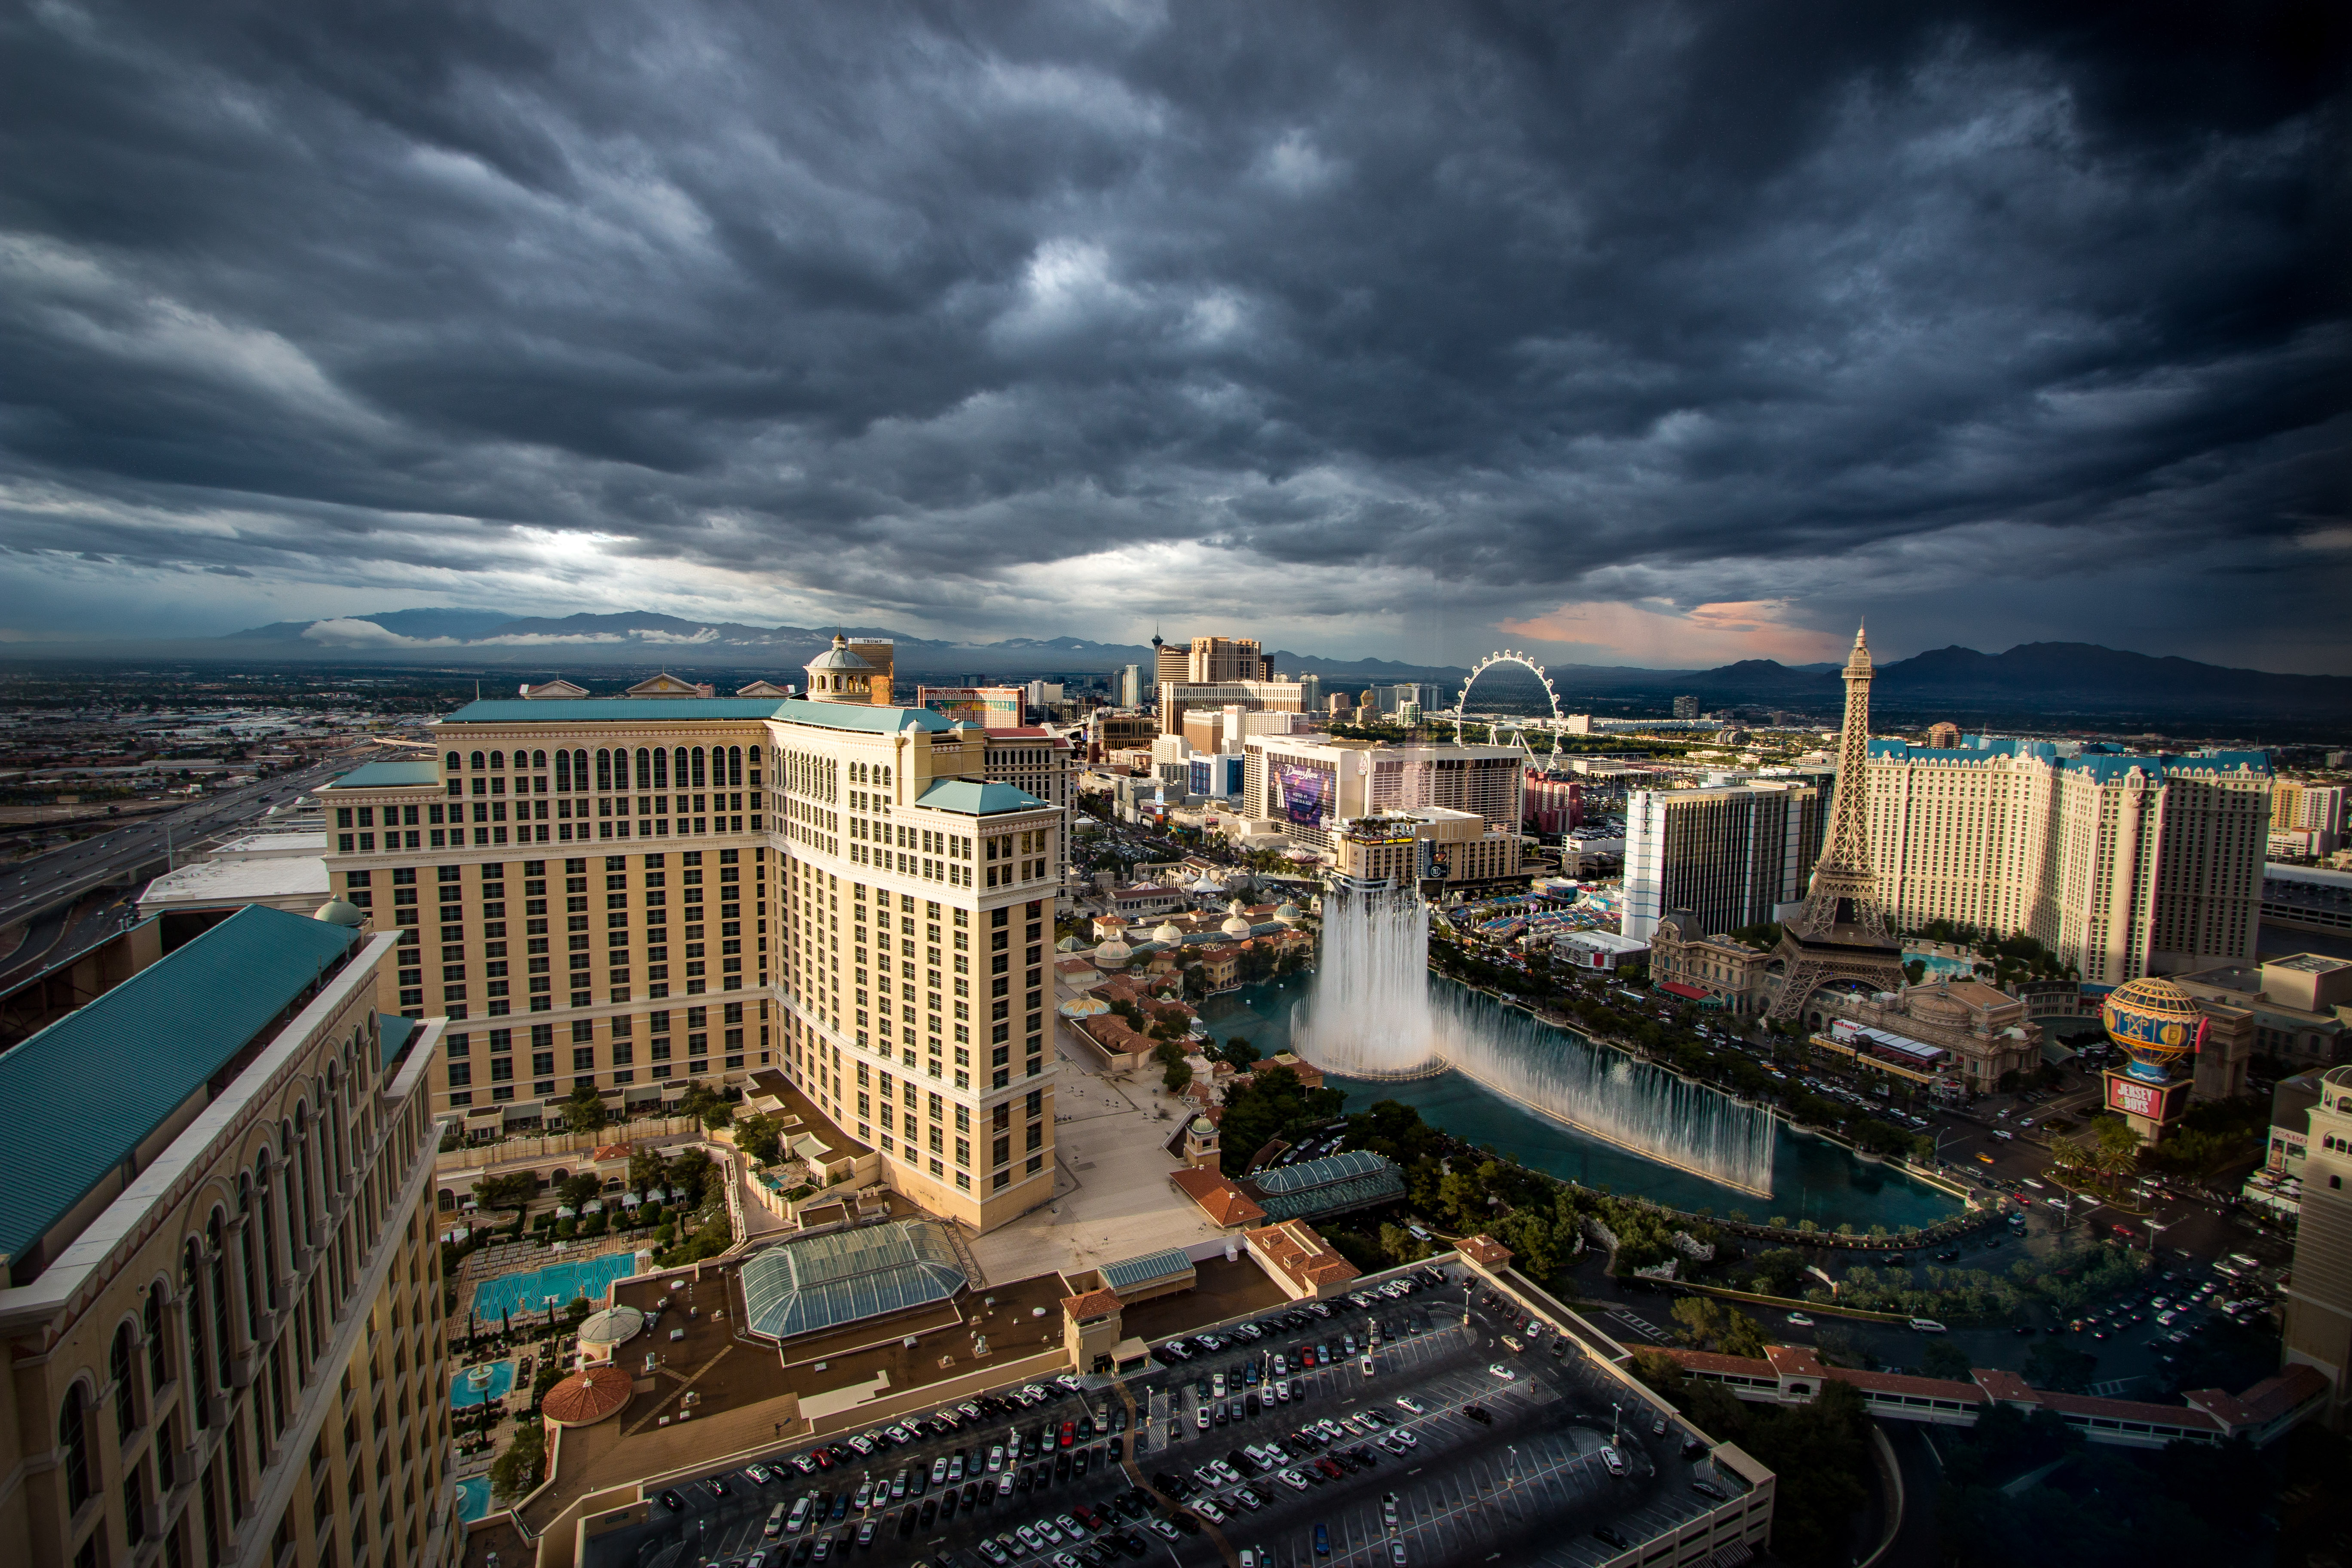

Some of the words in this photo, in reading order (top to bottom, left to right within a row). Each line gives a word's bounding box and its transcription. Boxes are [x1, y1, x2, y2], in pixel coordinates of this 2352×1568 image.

[1553, 943, 1581, 962] CVS
[2117, 1083, 2152, 1102] JERSEY
[2124, 1096, 2148, 1113] BOYS
